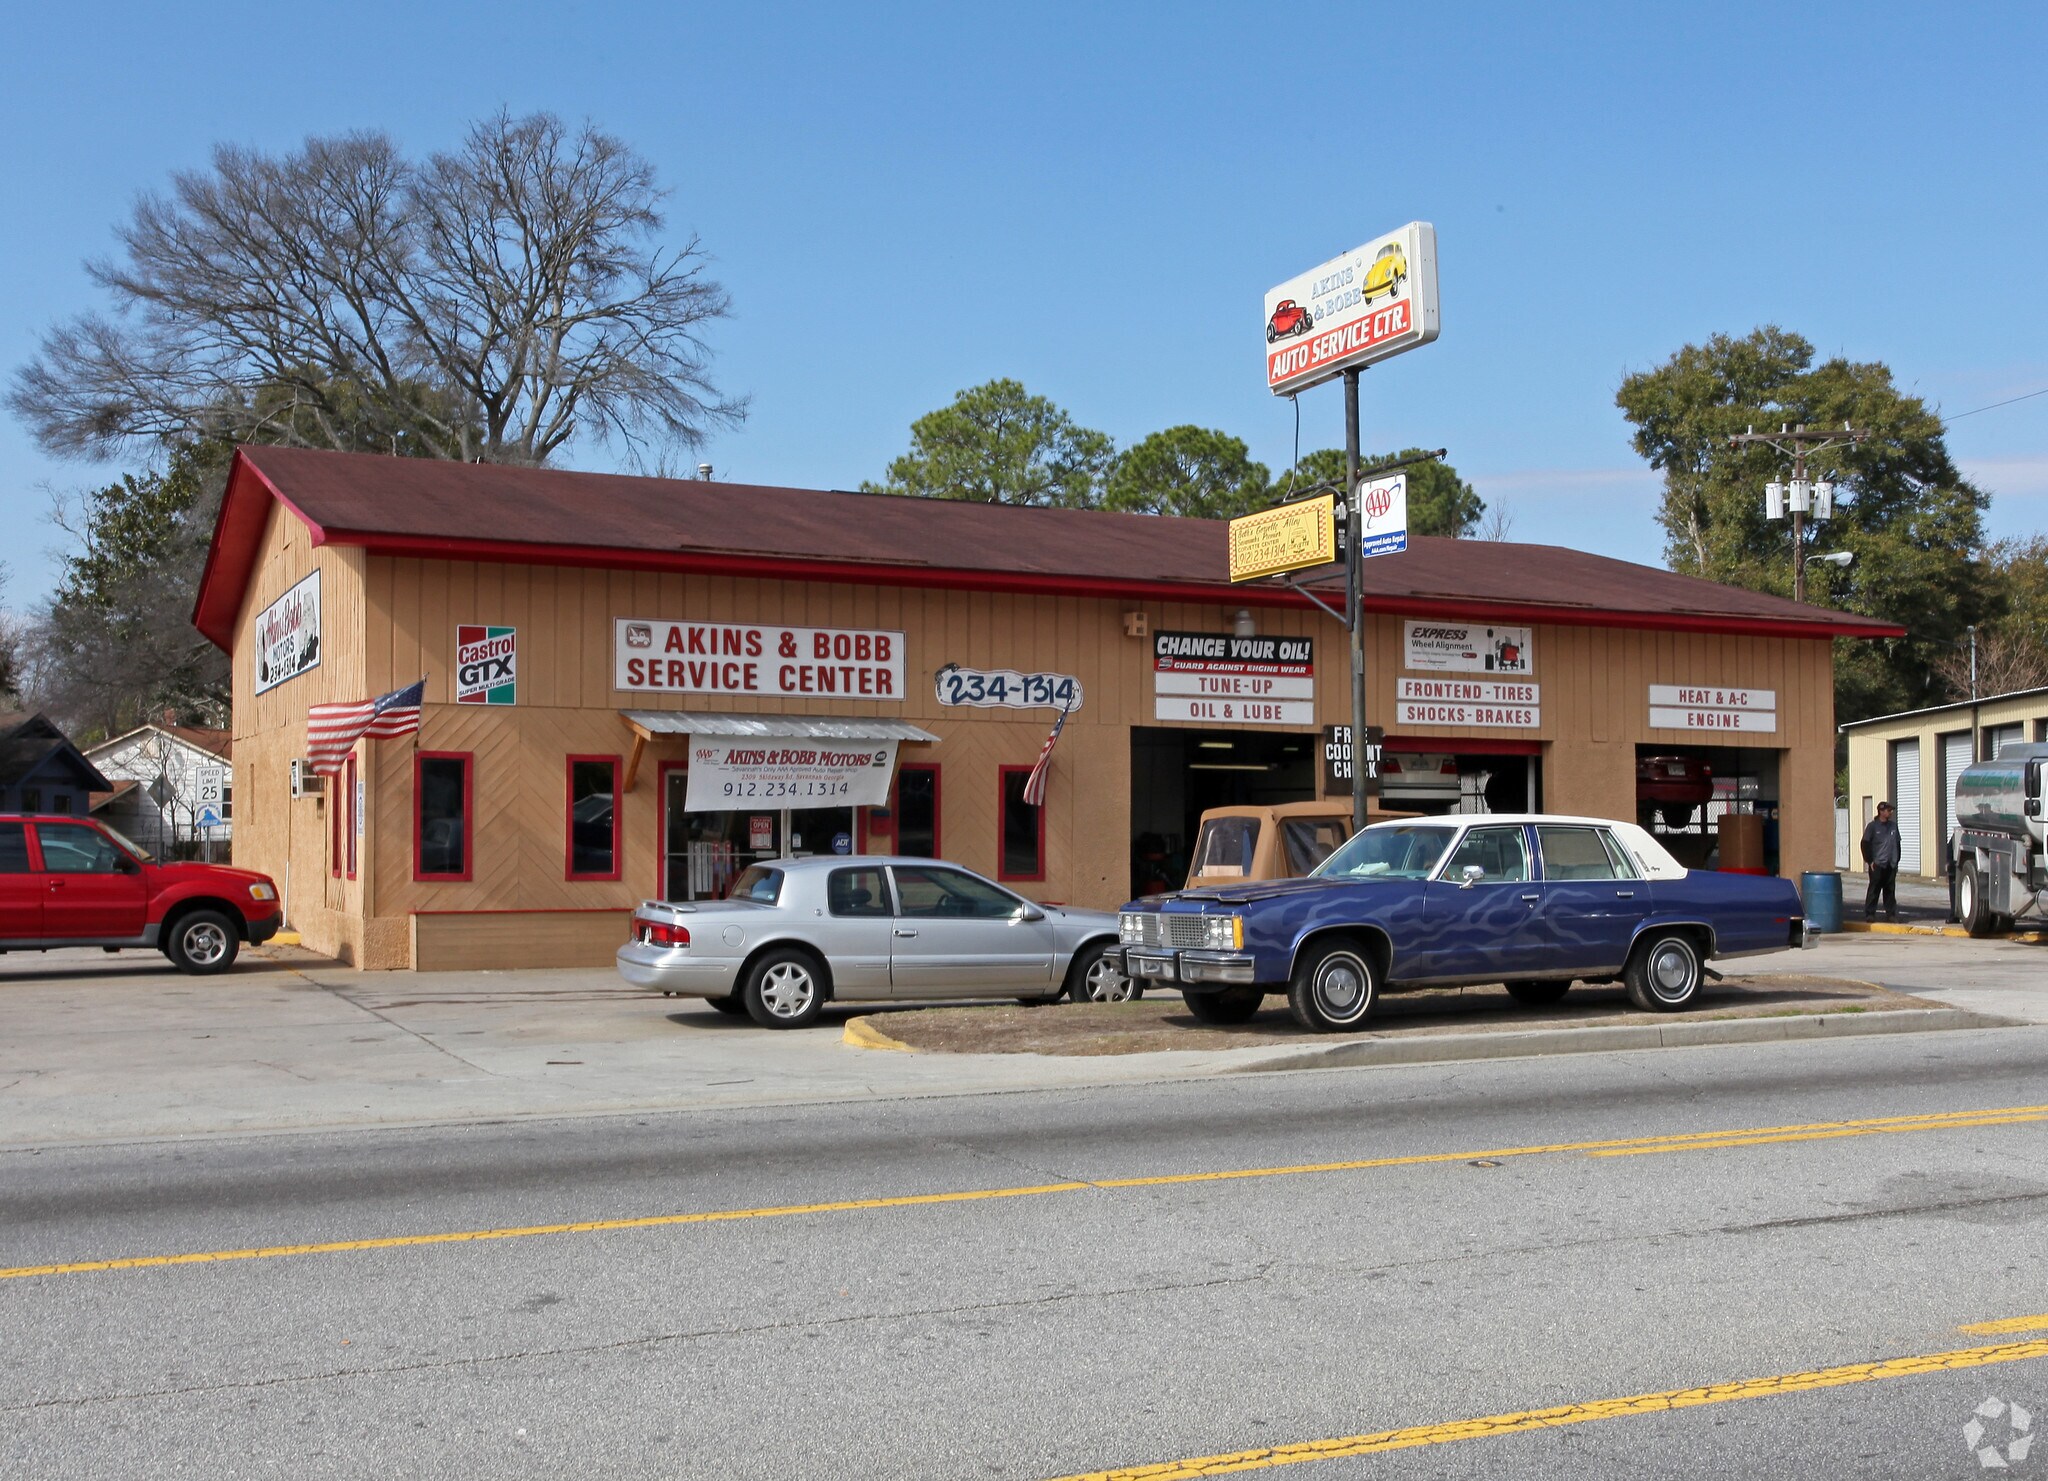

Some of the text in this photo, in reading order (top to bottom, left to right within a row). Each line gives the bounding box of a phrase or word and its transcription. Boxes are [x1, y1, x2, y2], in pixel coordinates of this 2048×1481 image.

[1311, 267, 1354, 300] AKINS
[1314, 287, 1362, 321] & BOBB
[1271, 304, 1408, 380] AUTO SERVICE CTR.
[1367, 488, 1390, 517] AAA
[1412, 627, 1468, 641] EXPRESS
[272, 635, 295, 664] MOTORS
[458, 634, 515, 665] Castrol
[664, 626, 892, 662] AKINS & BOBB
[1156, 636, 1311, 661] CHANGE YOUR OIL!
[1412, 640, 1473, 651] Wheel Alignment
[270, 654, 296, 684] 234-1314
[458, 654, 514, 686] GTX
[627, 658, 893, 695] SERVICE CENTER
[1174, 662, 1204, 670] GUARD
[1206, 663, 1245, 672] AGAINST
[1246, 664, 1279, 673] ENGINE
[1280, 666, 1307, 674] WEAR
[460, 687, 478, 696] SUPER
[947, 675, 1073, 706] 234-1314
[1199, 677, 1273, 695] TUNE-UP
[1679, 690, 1748, 706] HEAT & A-C
[1190, 702, 1282, 720] OIL & LUBE
[1688, 713, 1740, 728] ENGINE
[1334, 726, 1368, 744] FR
[724, 749, 766, 765] AKINS
[767, 750, 780, 765] &
[780, 750, 817, 765] BOBB
[818, 751, 872, 767] MOTORS
[1326, 744, 1383, 761] COONT
[1334, 761, 1377, 779] CHK
[202, 786, 218, 800] 25
[724, 782, 848, 796] 912.234.1314
